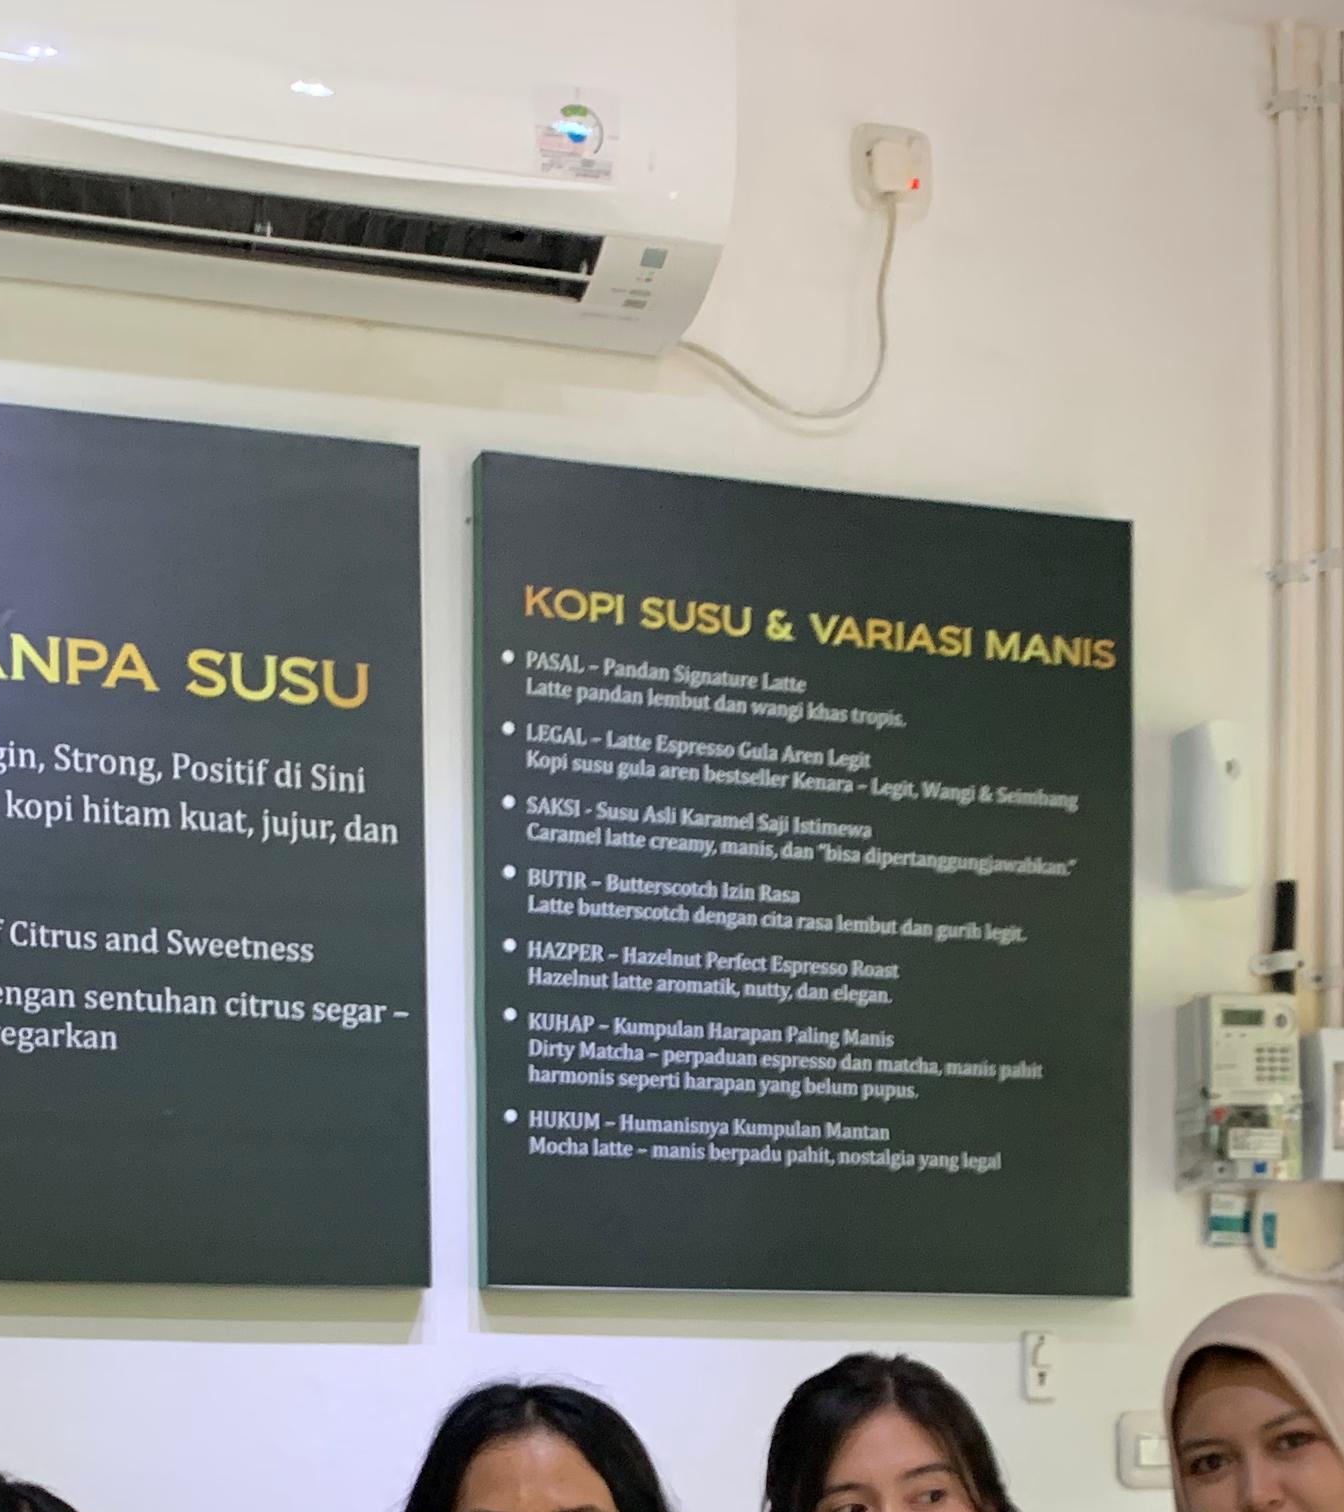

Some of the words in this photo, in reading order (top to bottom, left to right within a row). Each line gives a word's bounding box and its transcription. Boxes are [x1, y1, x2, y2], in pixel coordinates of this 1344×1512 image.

[524, 584, 626, 626] KOPI
[639, 596, 754, 638] SUSU
[765, 608, 796, 643] &
[808, 612, 973, 658] VARIASI
[984, 629, 1117, 669] MANIS
[185, 648, 370, 709] SUSU
[526, 652, 585, 674] PASAL
[603, 659, 669, 681] Pandan
[673, 666, 758, 689] Signature
[762, 673, 807, 693] Latte
[526, 678, 572, 698] Latte
[576, 686, 643, 705] pandan
[647, 689, 711, 711] lembut
[714, 695, 747, 714] dan
[750, 703, 803, 722] wangi
[807, 703, 848, 722] khas
[851, 709, 907, 728] tropis.
[54, 744, 162, 785] Strong,
[172, 753, 269, 786] Positif
[275, 761, 302, 789] di
[311, 764, 365, 794] Sini
[526, 724, 587, 746] LEGAL
[606, 731, 652, 751] Latte
[656, 736, 735, 758] Espresso
[738, 742, 778, 761] Gula
[781, 746, 824, 765] Aren
[827, 750, 871, 771] Legit
[6, 790, 72, 827] kopi
[83, 795, 170, 828] hitam
[180, 802, 253, 838] kuat,
[262, 809, 336, 844] jujur,
[344, 814, 398, 844] dan
[527, 797, 580, 817] SAKSI
[596, 803, 639, 822] Susu
[642, 807, 676, 824] Asli
[680, 809, 754, 830] Karamel
[757, 815, 789, 835] Saji
[793, 818, 872, 838] Istimewa
[10, 921, 97, 950] Citrus
[106, 928, 159, 954] and
[168, 929, 314, 962] Sweetness
[85, 987, 217, 1015] sentuhan
[225, 992, 305, 1021] citrus
[312, 1002, 387, 1029] segar
